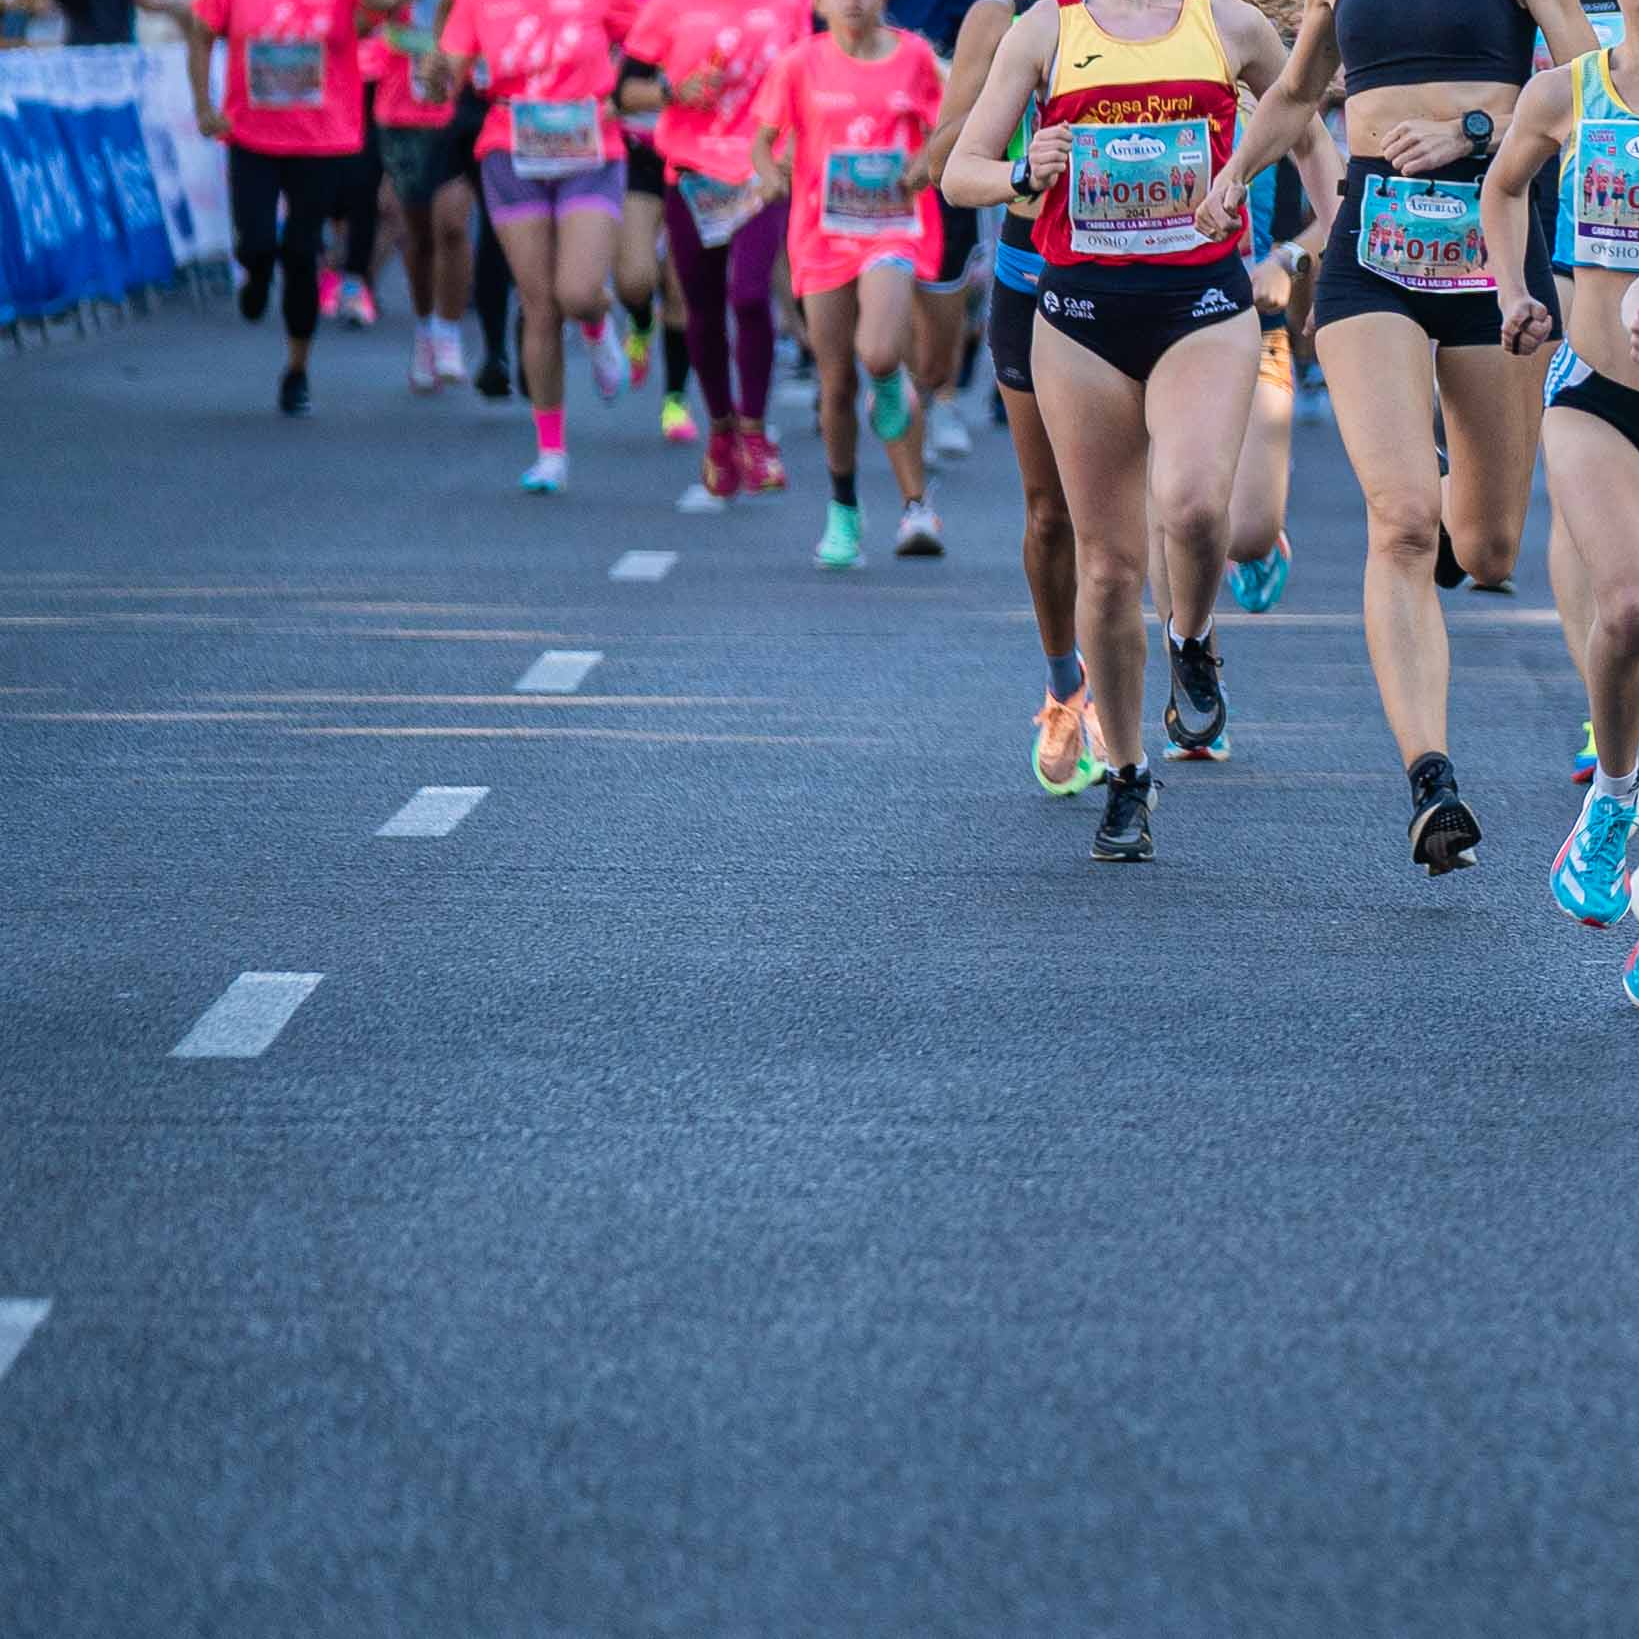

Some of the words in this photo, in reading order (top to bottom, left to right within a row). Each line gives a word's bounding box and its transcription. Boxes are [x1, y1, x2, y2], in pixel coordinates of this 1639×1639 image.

[1098, 99, 1142, 115] Casa
[1148, 95, 1193, 112] Rural
[1113, 181, 1166, 203] 016
[1126, 208, 1151, 218] 2041
[1087, 234, 1128, 248] OYSHO
[1628, 230, 1639, 239] DE
[1406, 239, 1461, 262] 016
[1591, 244, 1639, 259] OYSHO
[1423, 267, 1436, 276] 31
